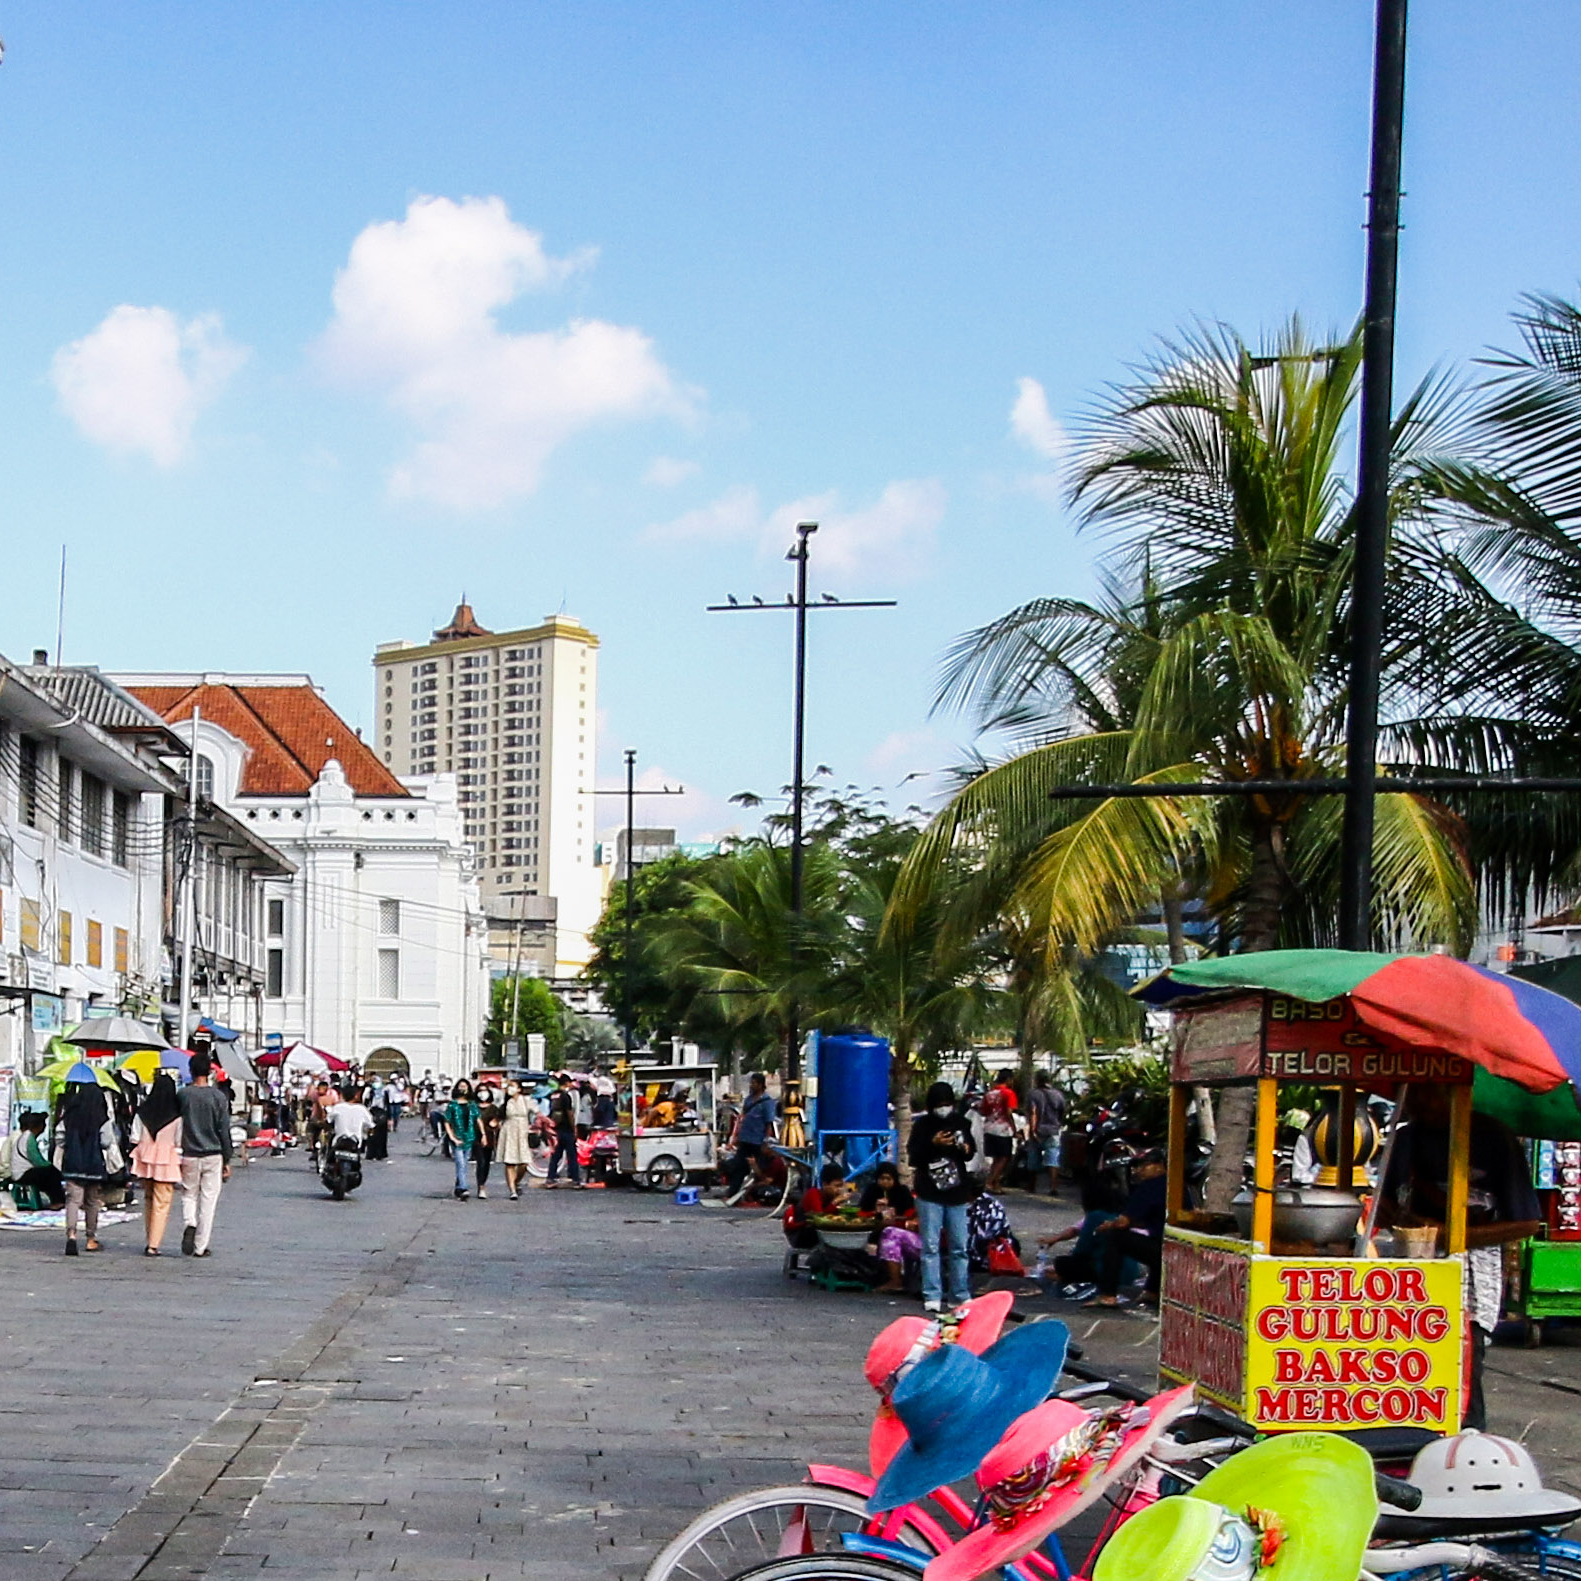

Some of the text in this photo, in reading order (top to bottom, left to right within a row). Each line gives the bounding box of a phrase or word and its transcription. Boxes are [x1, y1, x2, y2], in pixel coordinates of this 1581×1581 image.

[1271, 1000, 1343, 1020] BASO
[1267, 1052, 1463, 1078] TELOR GULUNG
[1279, 1268, 1428, 1304] TELOR
[1256, 1306, 1450, 1343] GULUNG
[1274, 1349, 1431, 1386] BAKSO
[1255, 1387, 1449, 1423] MERCON
